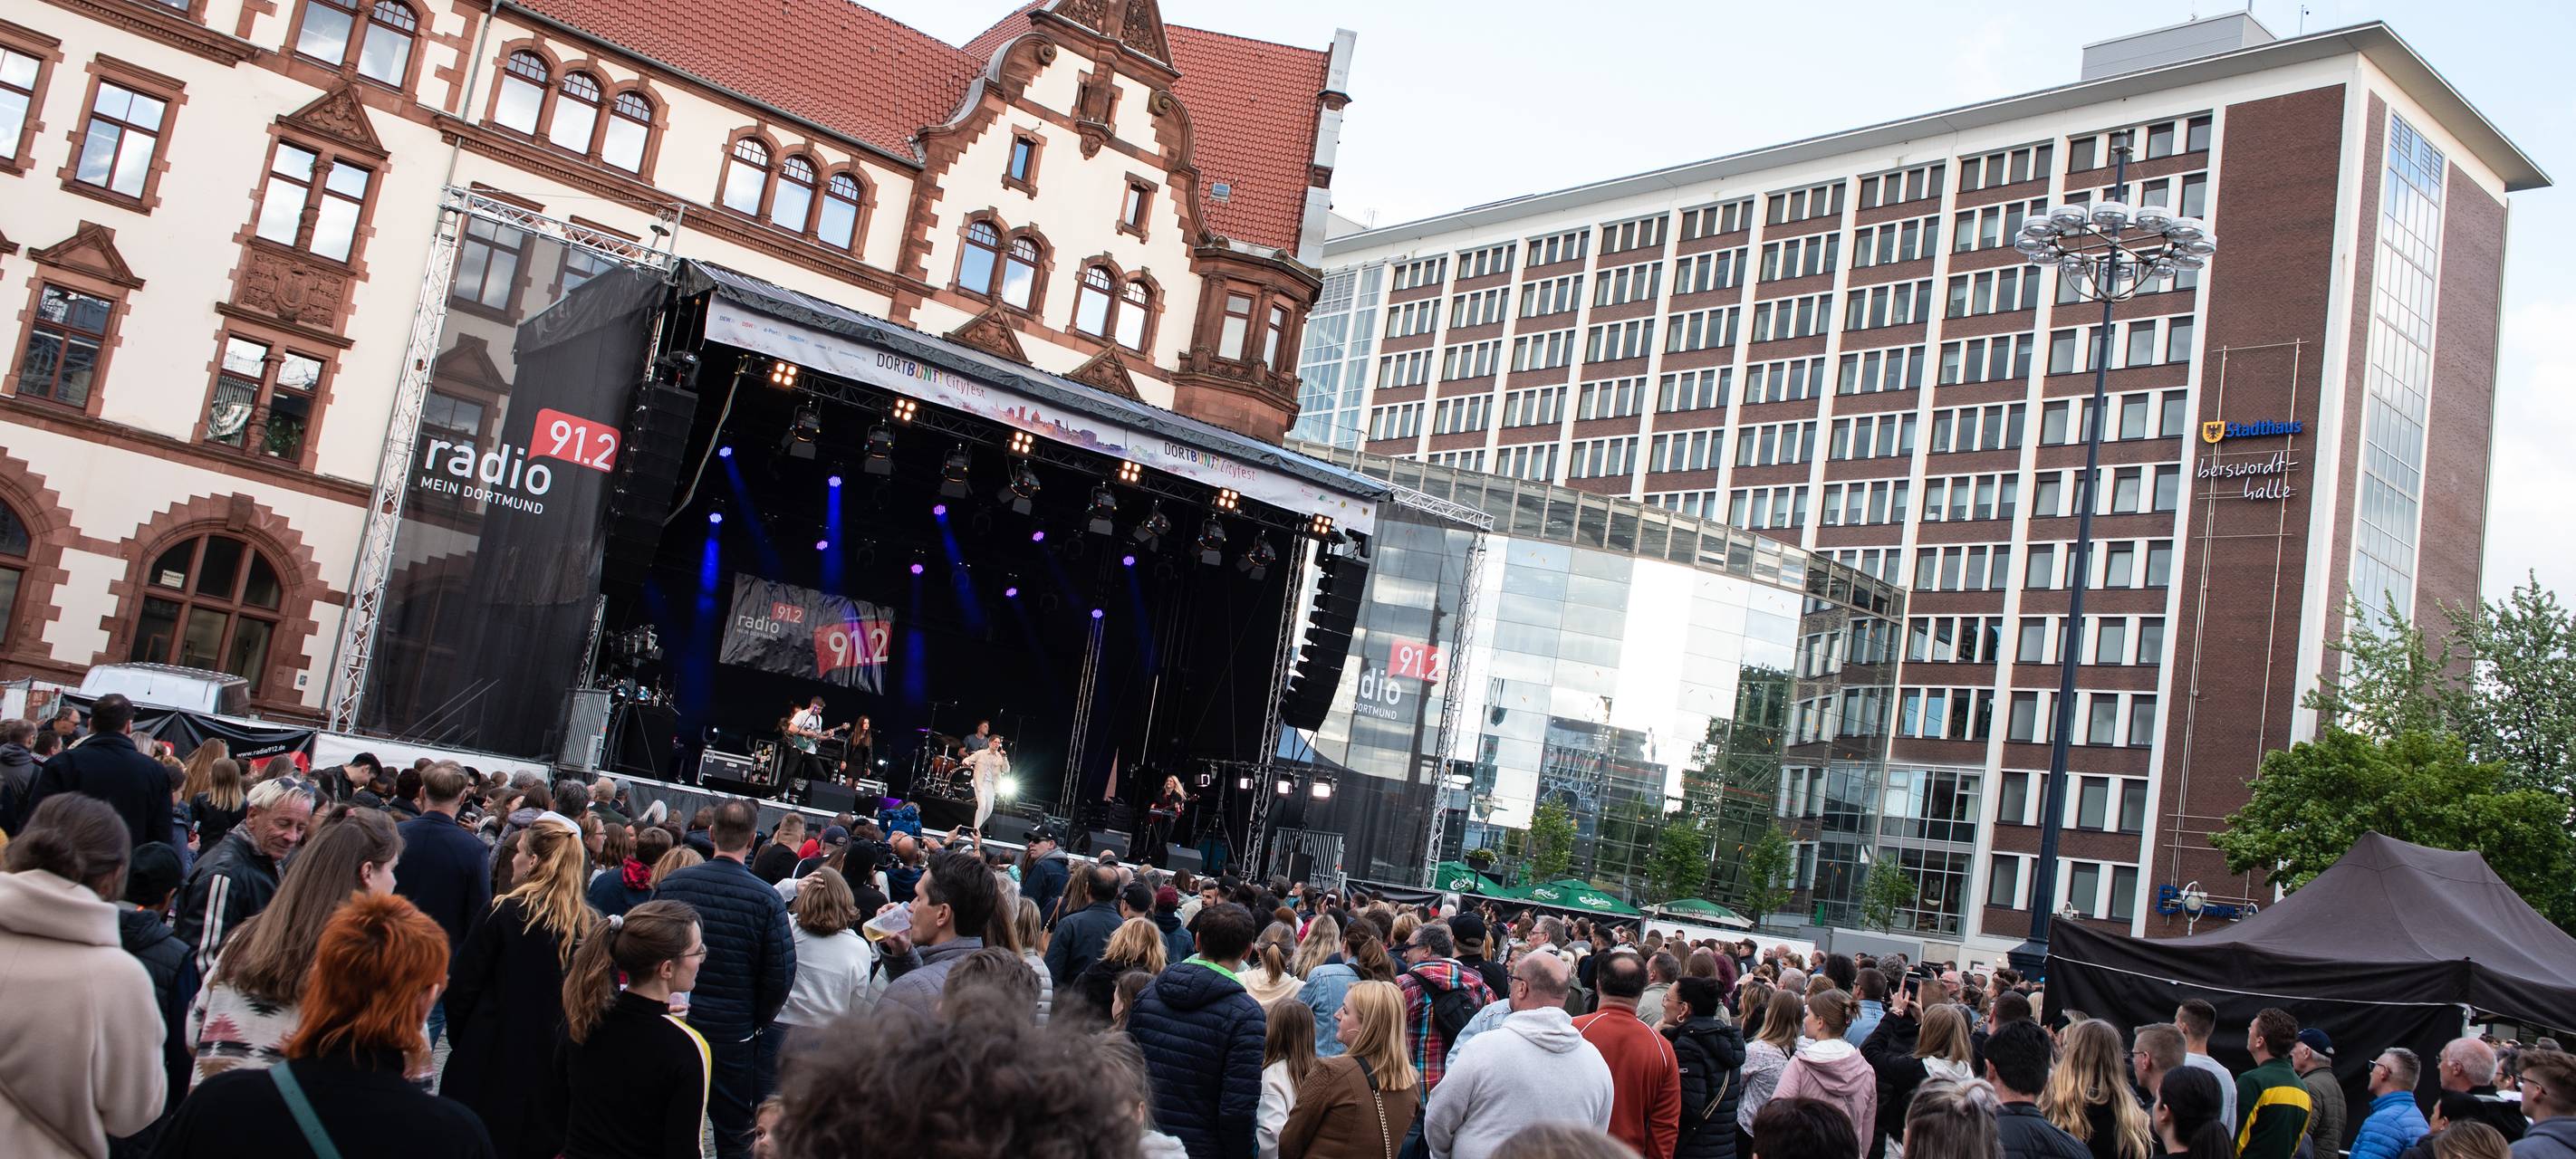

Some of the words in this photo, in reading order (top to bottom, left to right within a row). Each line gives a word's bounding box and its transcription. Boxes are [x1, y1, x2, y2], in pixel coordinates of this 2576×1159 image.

[877, 352, 943, 385] DORTBUNT!
[946, 374, 985, 399] Cityfest
[2225, 419, 2304, 437] Stadthaus
[550, 420, 616, 471] 91.2
[424, 438, 552, 495] radio
[1220, 459, 1256, 481] Cityfest
[2197, 450, 2299, 478] berswordt-
[420, 476, 459, 495] MEIN
[463, 485, 543, 514] DORTMUND
[2244, 476, 2291, 500] halle
[736, 615, 780, 634] radio
[777, 606, 803, 624] 91.2
[828, 627, 889, 666] 91.2
[1399, 646, 1445, 683] 91.2
[1352, 702, 1398, 721] DORTMUND
[236, 744, 286, 757] www.radio912.de
